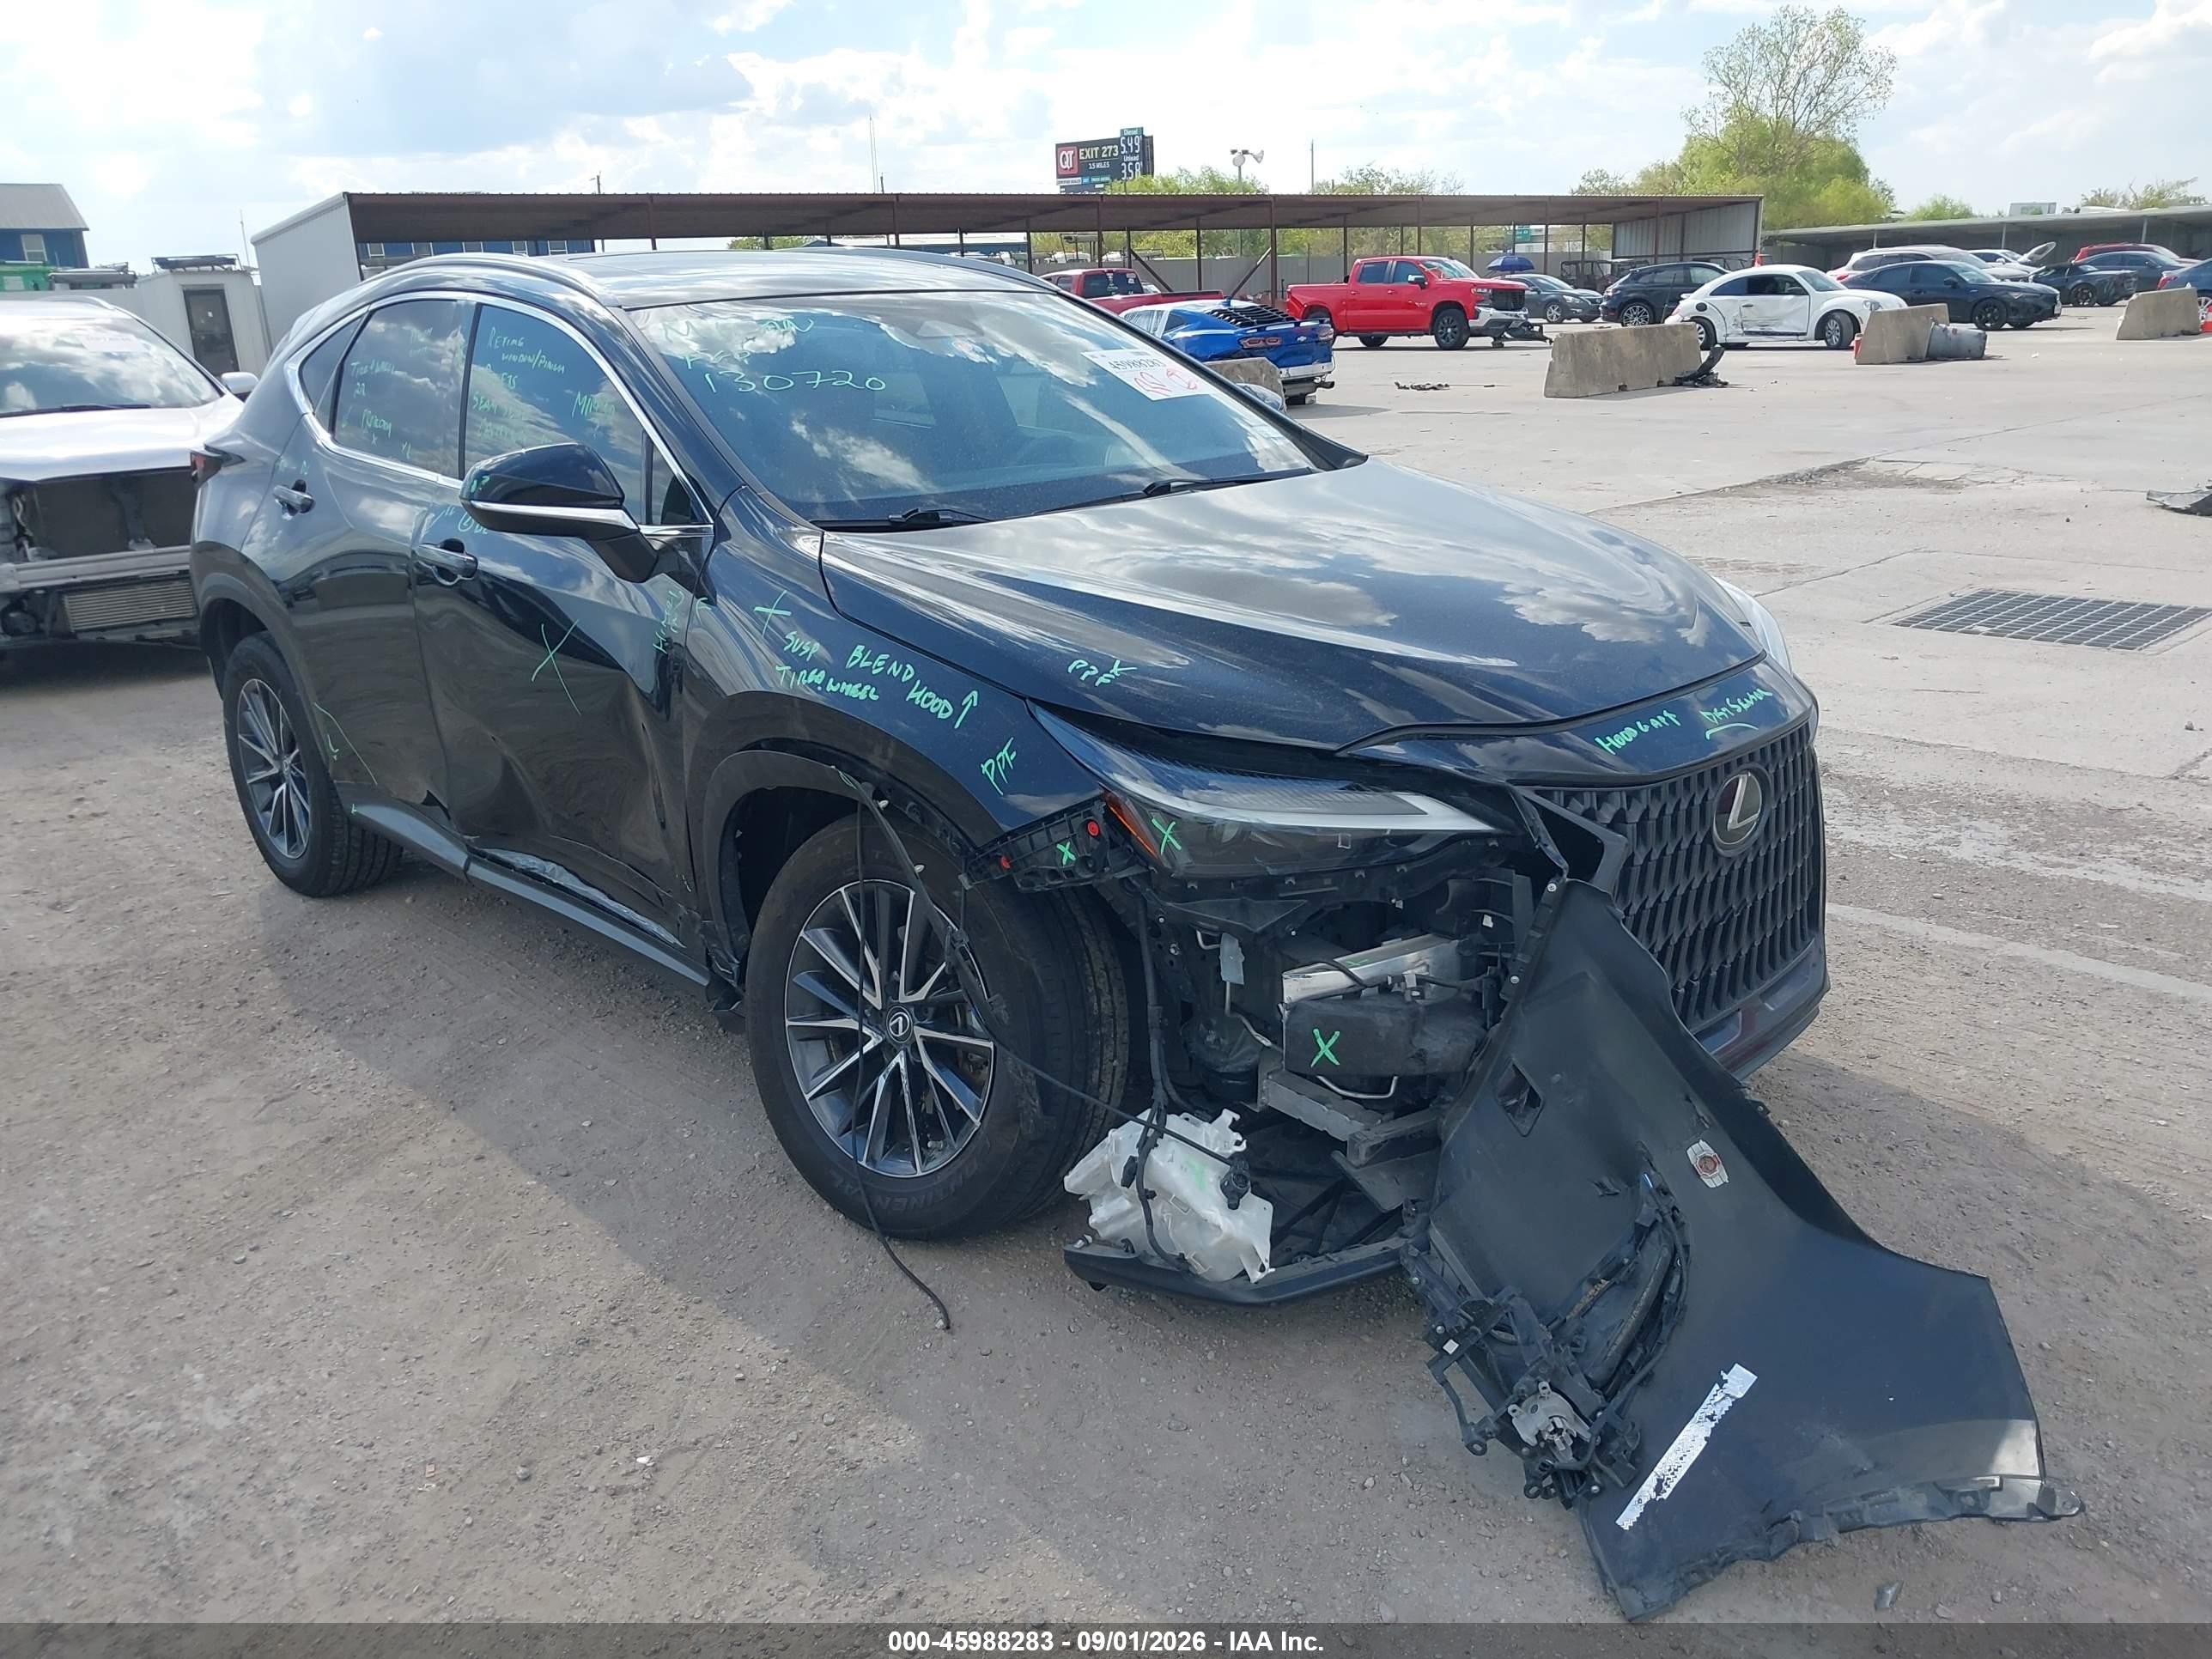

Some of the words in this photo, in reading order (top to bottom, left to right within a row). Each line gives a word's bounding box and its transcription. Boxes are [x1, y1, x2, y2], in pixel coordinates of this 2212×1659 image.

[1060, 150, 1073, 170] QT
[1079, 148, 1099, 161] EXIT
[1102, 145, 1118, 158] 273
[705, 370, 886, 392] 130720
[783, 631, 820, 661] SUSP
[846, 645, 915, 683] BLEND
[906, 680, 954, 720] HOOD
